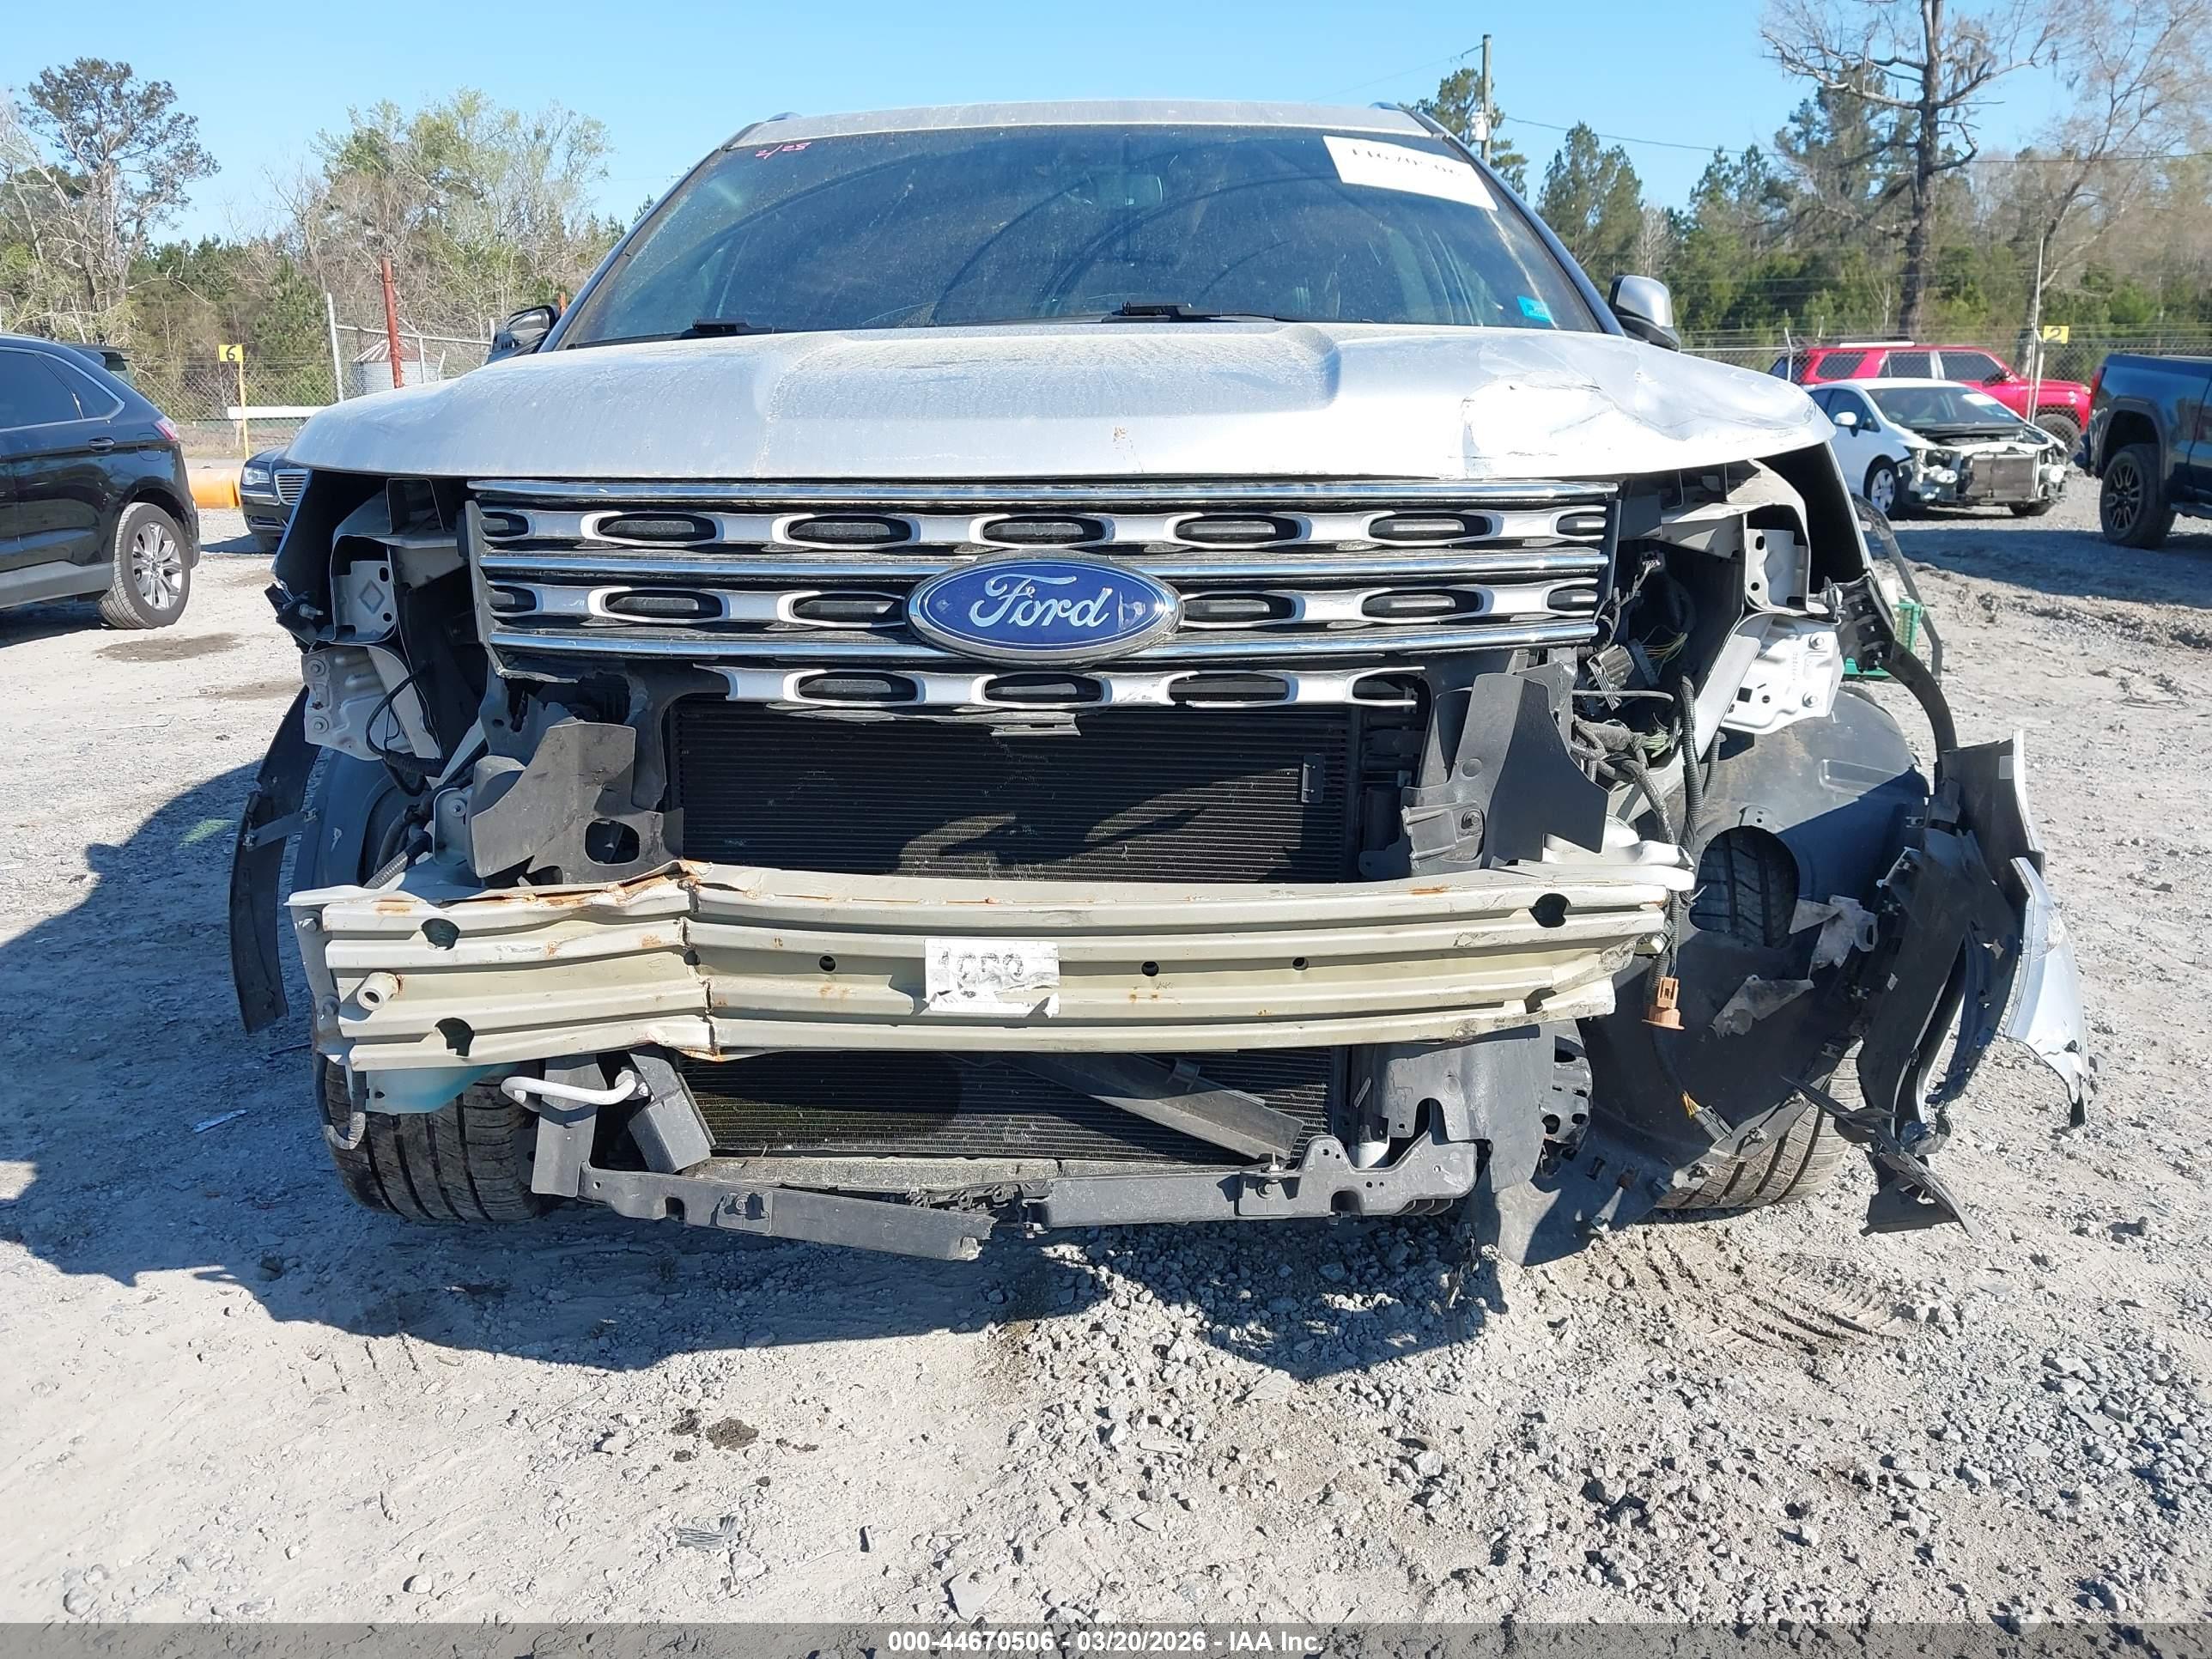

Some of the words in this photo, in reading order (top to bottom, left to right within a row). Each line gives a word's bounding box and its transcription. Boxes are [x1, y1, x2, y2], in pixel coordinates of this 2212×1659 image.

[2045, 327, 2062, 343] 2
[226, 345, 236, 360] 6
[969, 573, 1114, 628] Ford
